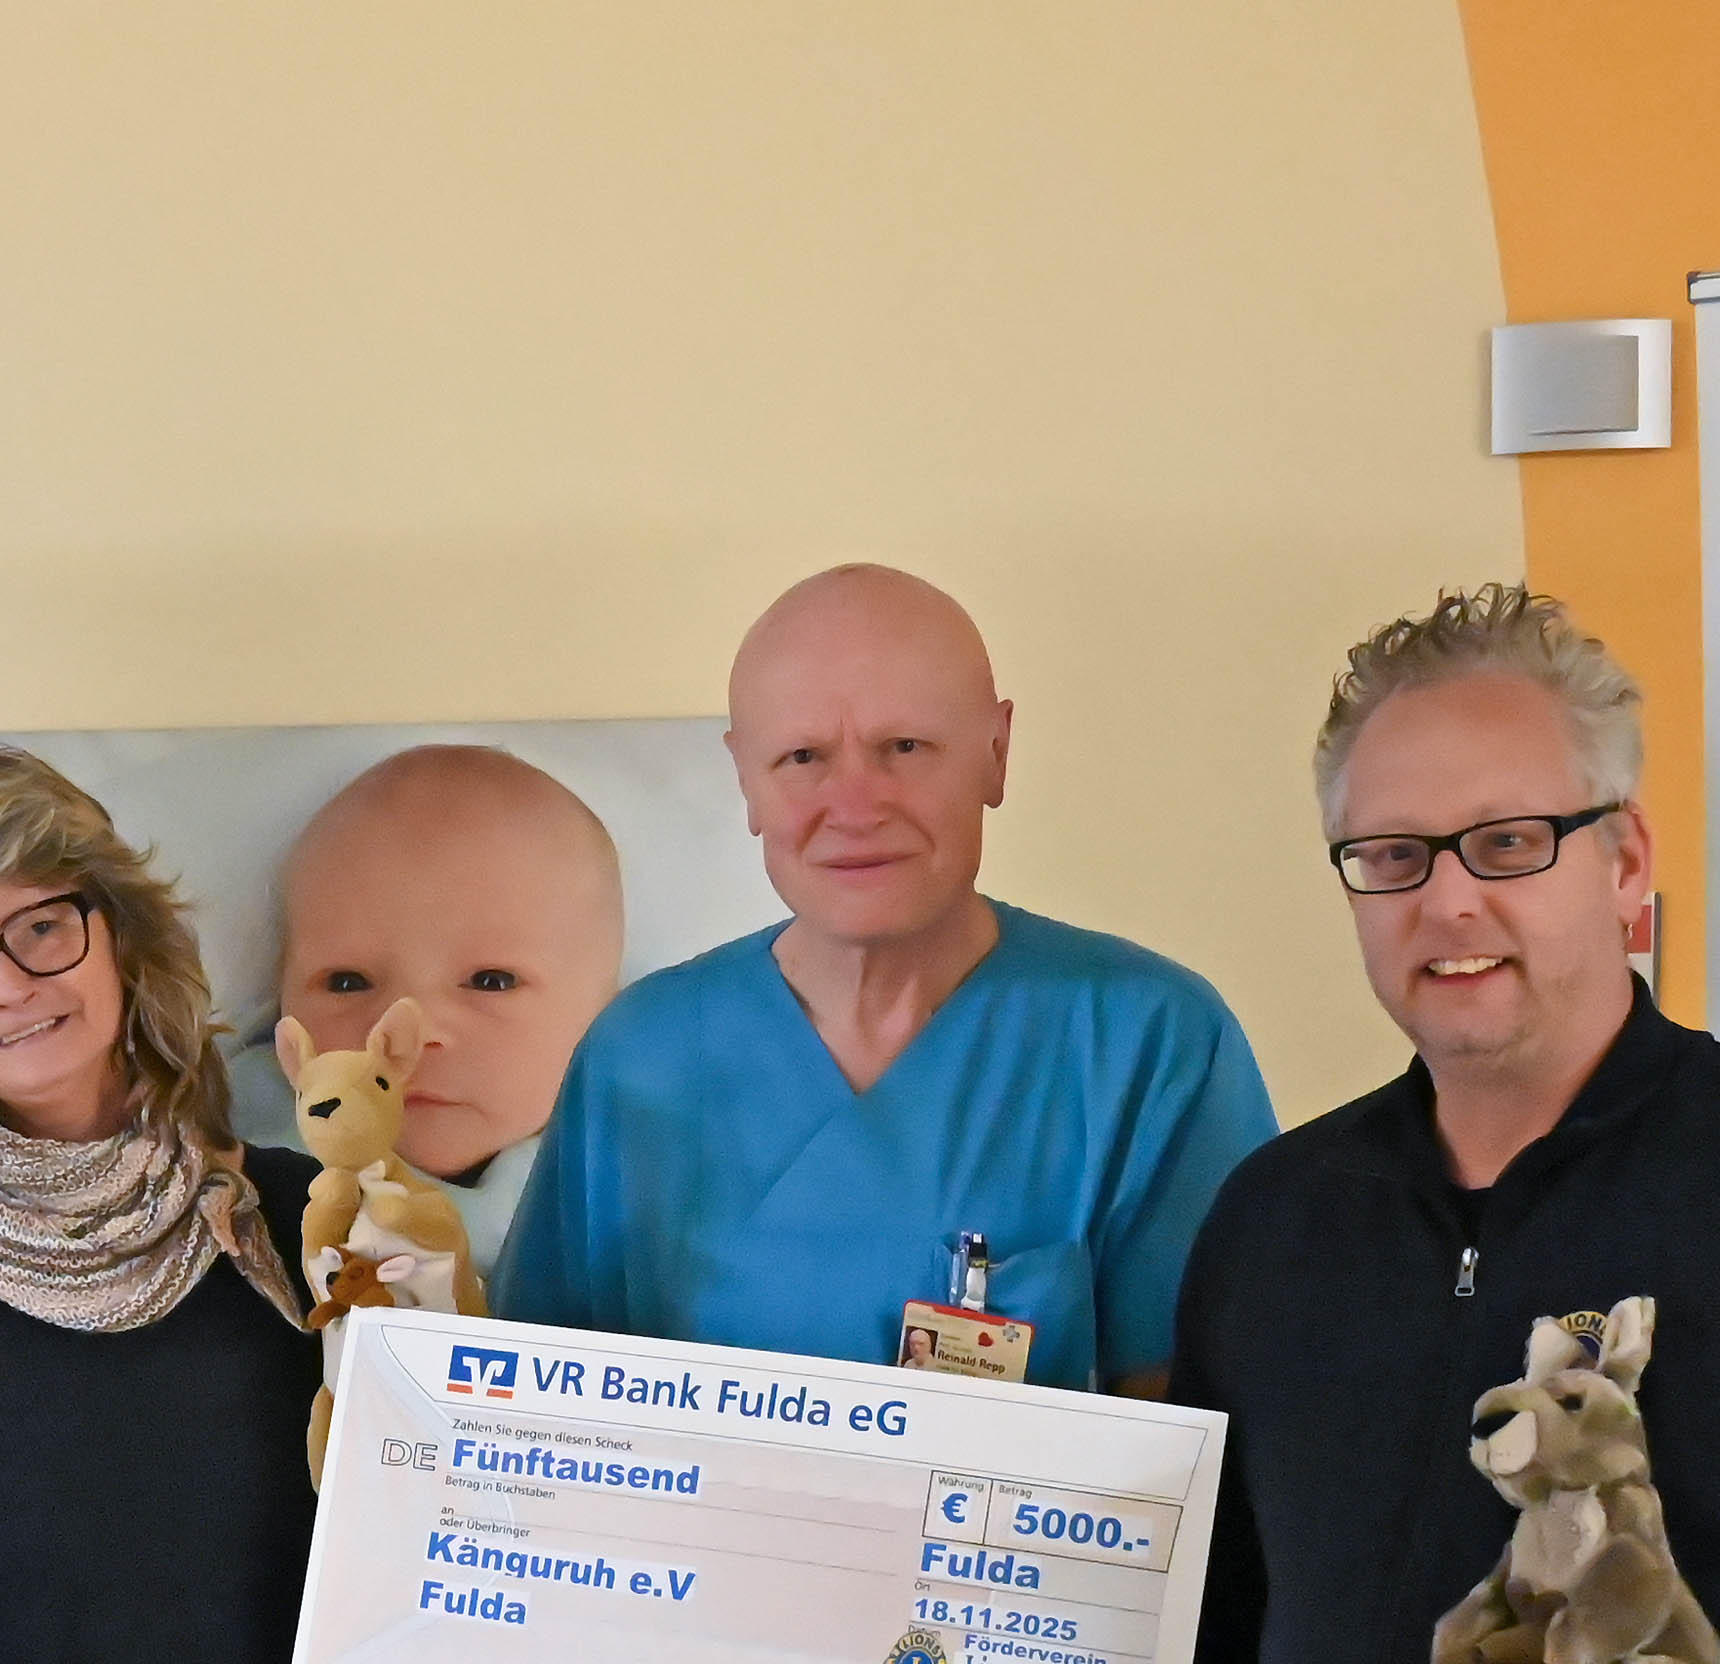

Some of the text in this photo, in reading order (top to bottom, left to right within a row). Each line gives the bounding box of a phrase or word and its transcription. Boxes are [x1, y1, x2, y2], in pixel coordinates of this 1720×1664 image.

[532, 1356, 909, 1437] VR Bank Fulda eG
[452, 1418, 634, 1452] Zahlen Sie gegen diesen Scheck
[380, 1437, 439, 1472] DE
[452, 1438, 700, 1495] Fünftausend
[445, 1474, 556, 1501] Betrag in Buchstaben
[937, 1475, 985, 1493] Währung
[998, 1484, 1033, 1500] Betrag
[439, 1517, 464, 1529] oder
[440, 1506, 455, 1516] an
[940, 1492, 969, 1524] €
[1012, 1503, 1150, 1552] 5000.-
[426, 1531, 697, 1601] Känguruh e.V
[920, 1542, 1041, 1590] Fulda
[419, 1580, 528, 1625] Fulda
[914, 1598, 1079, 1641] 18.11.2025
[902, 1634, 941, 1656] LIONS
